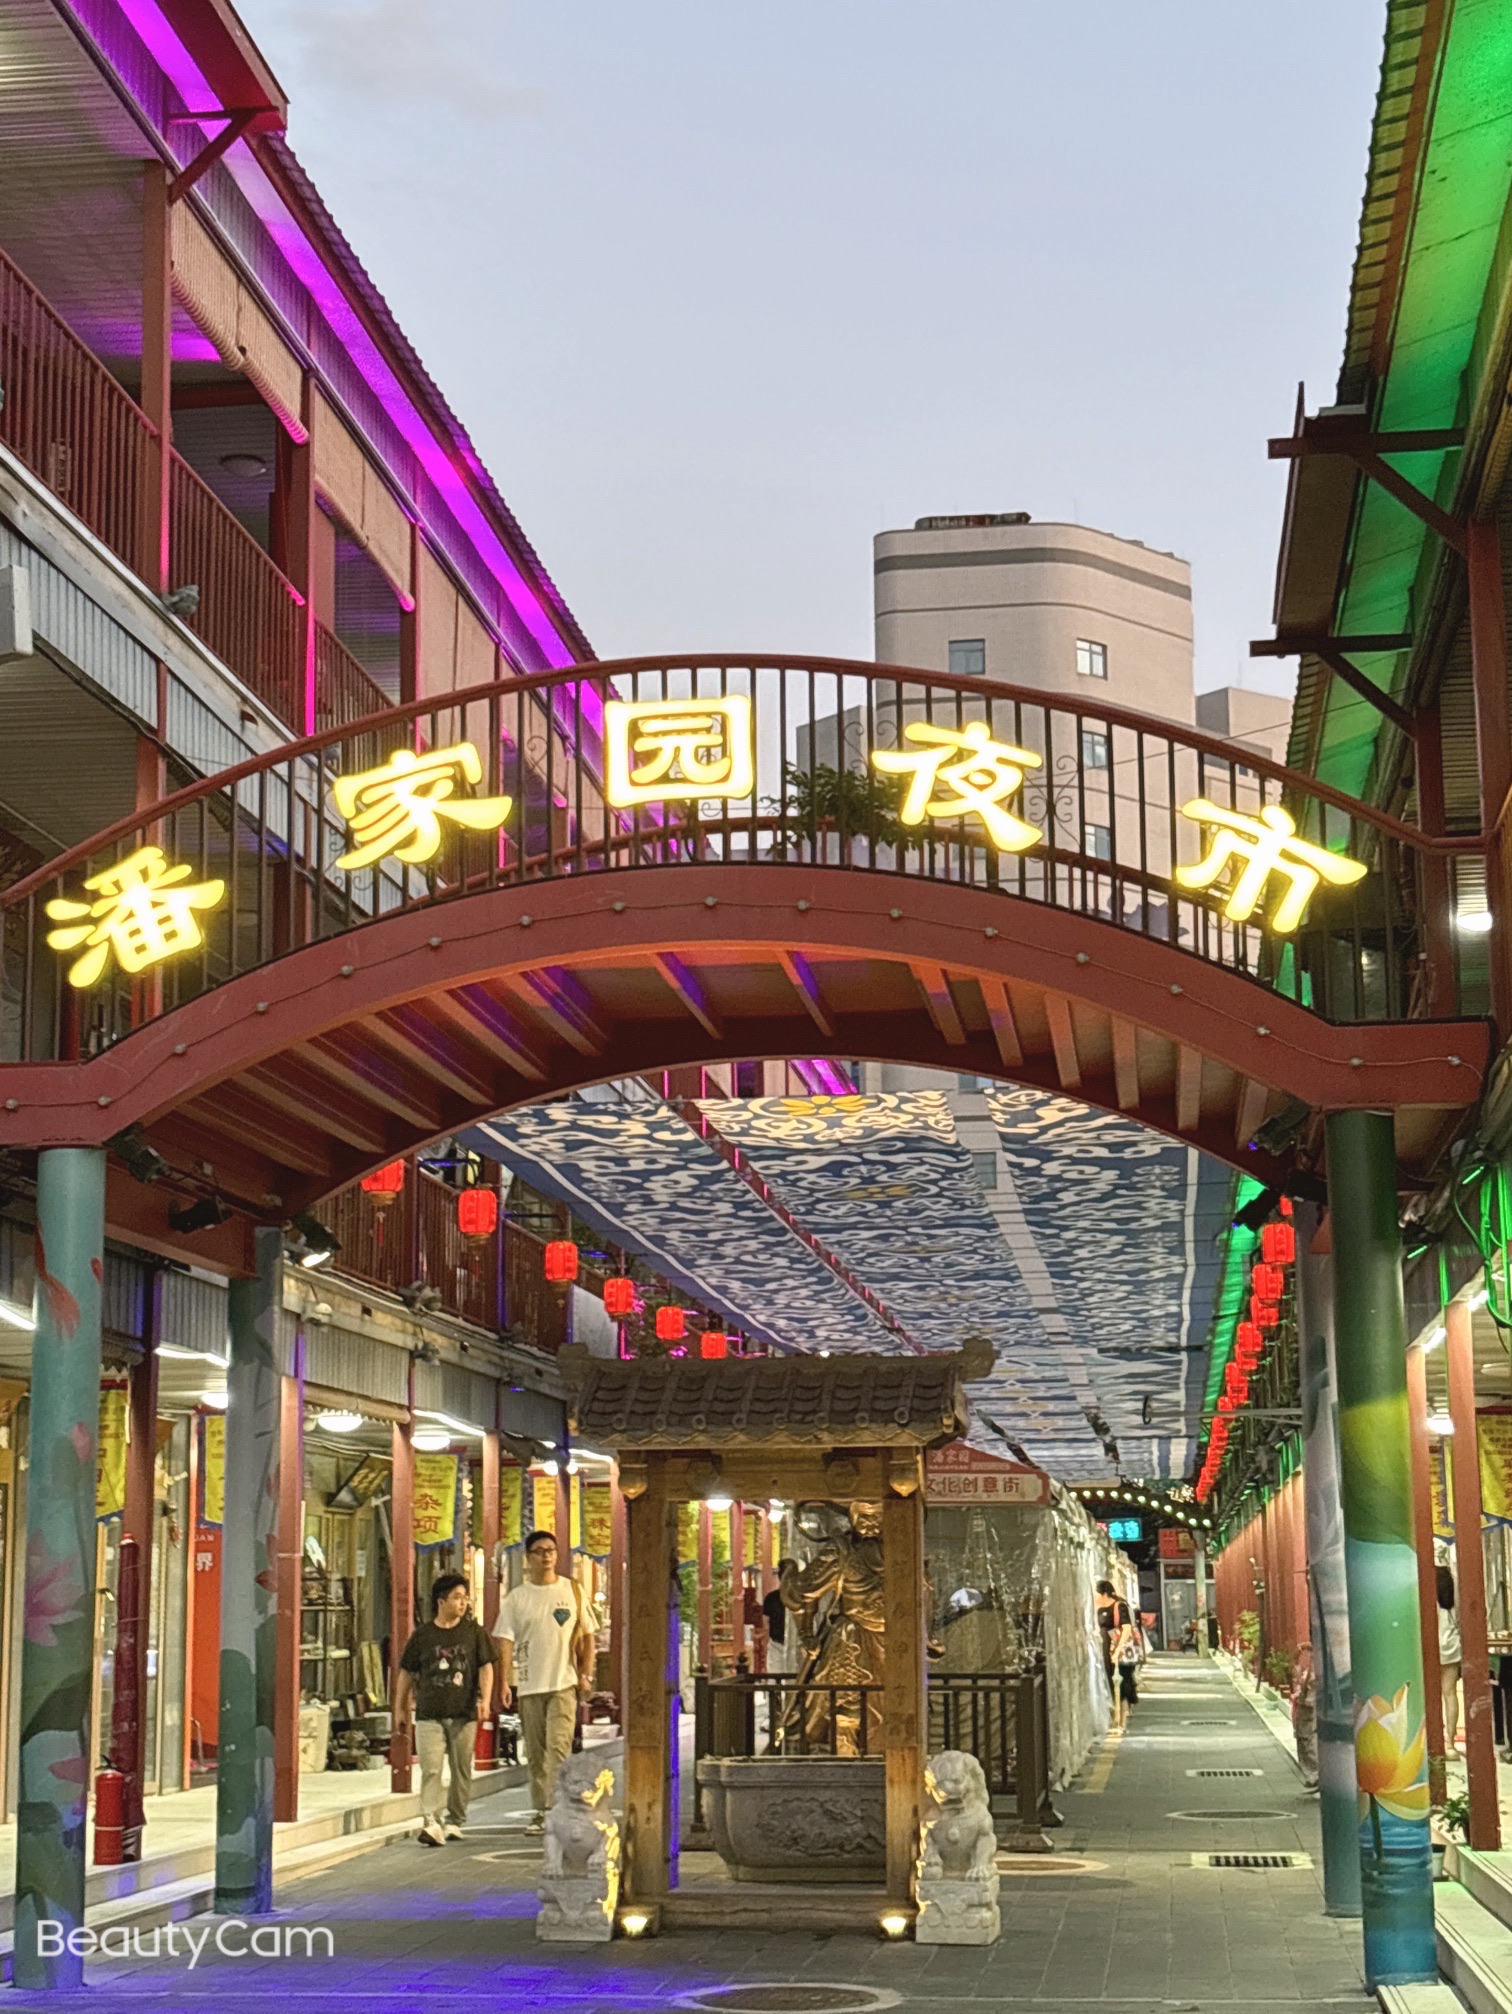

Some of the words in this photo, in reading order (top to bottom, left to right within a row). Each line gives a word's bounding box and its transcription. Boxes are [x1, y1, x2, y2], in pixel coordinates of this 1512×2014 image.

[46, 694, 1368, 988] 潘家园夜市
